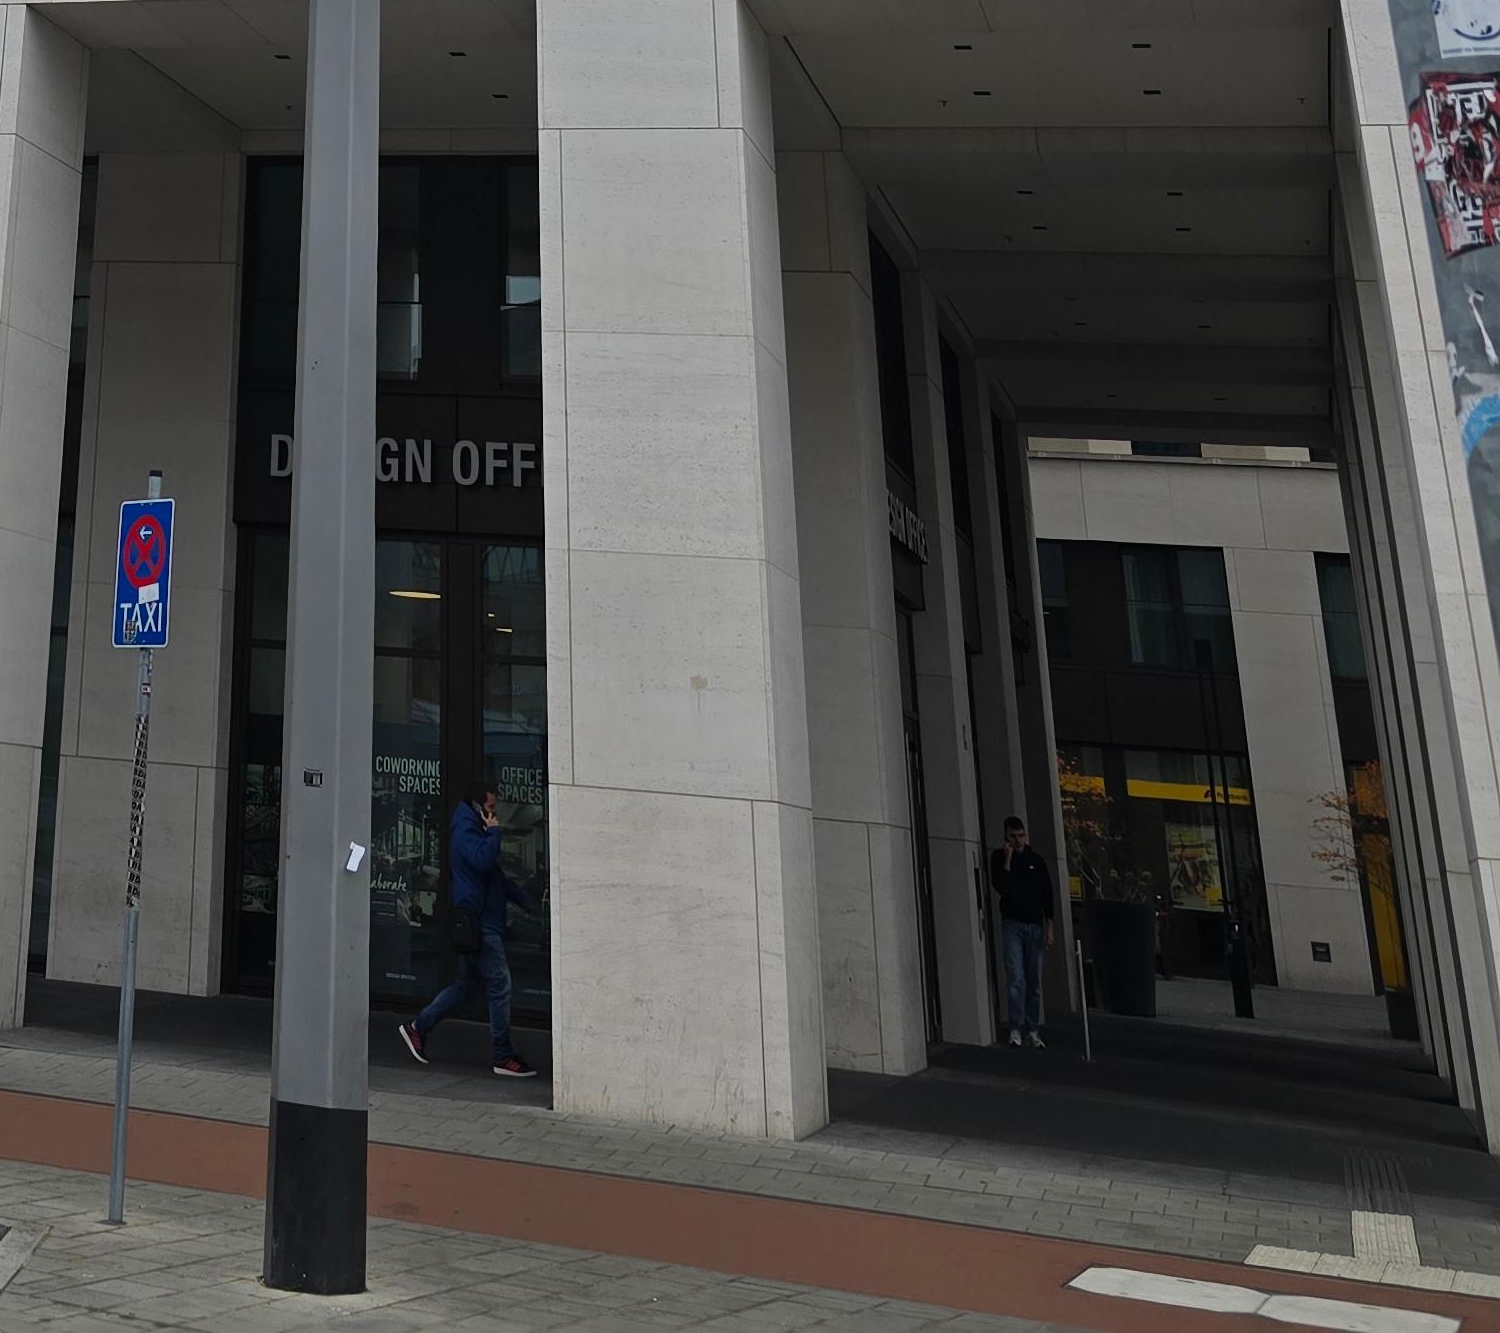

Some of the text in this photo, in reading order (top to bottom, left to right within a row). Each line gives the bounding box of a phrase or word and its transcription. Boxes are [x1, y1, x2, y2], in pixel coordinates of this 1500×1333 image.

[270, 433, 544, 487] DGN OFF
[119, 601, 163, 633] TAXI
[398, 775, 442, 796] SPACES
[501, 766, 543, 787] OFFICE
[497, 782, 543, 804] SPACES
